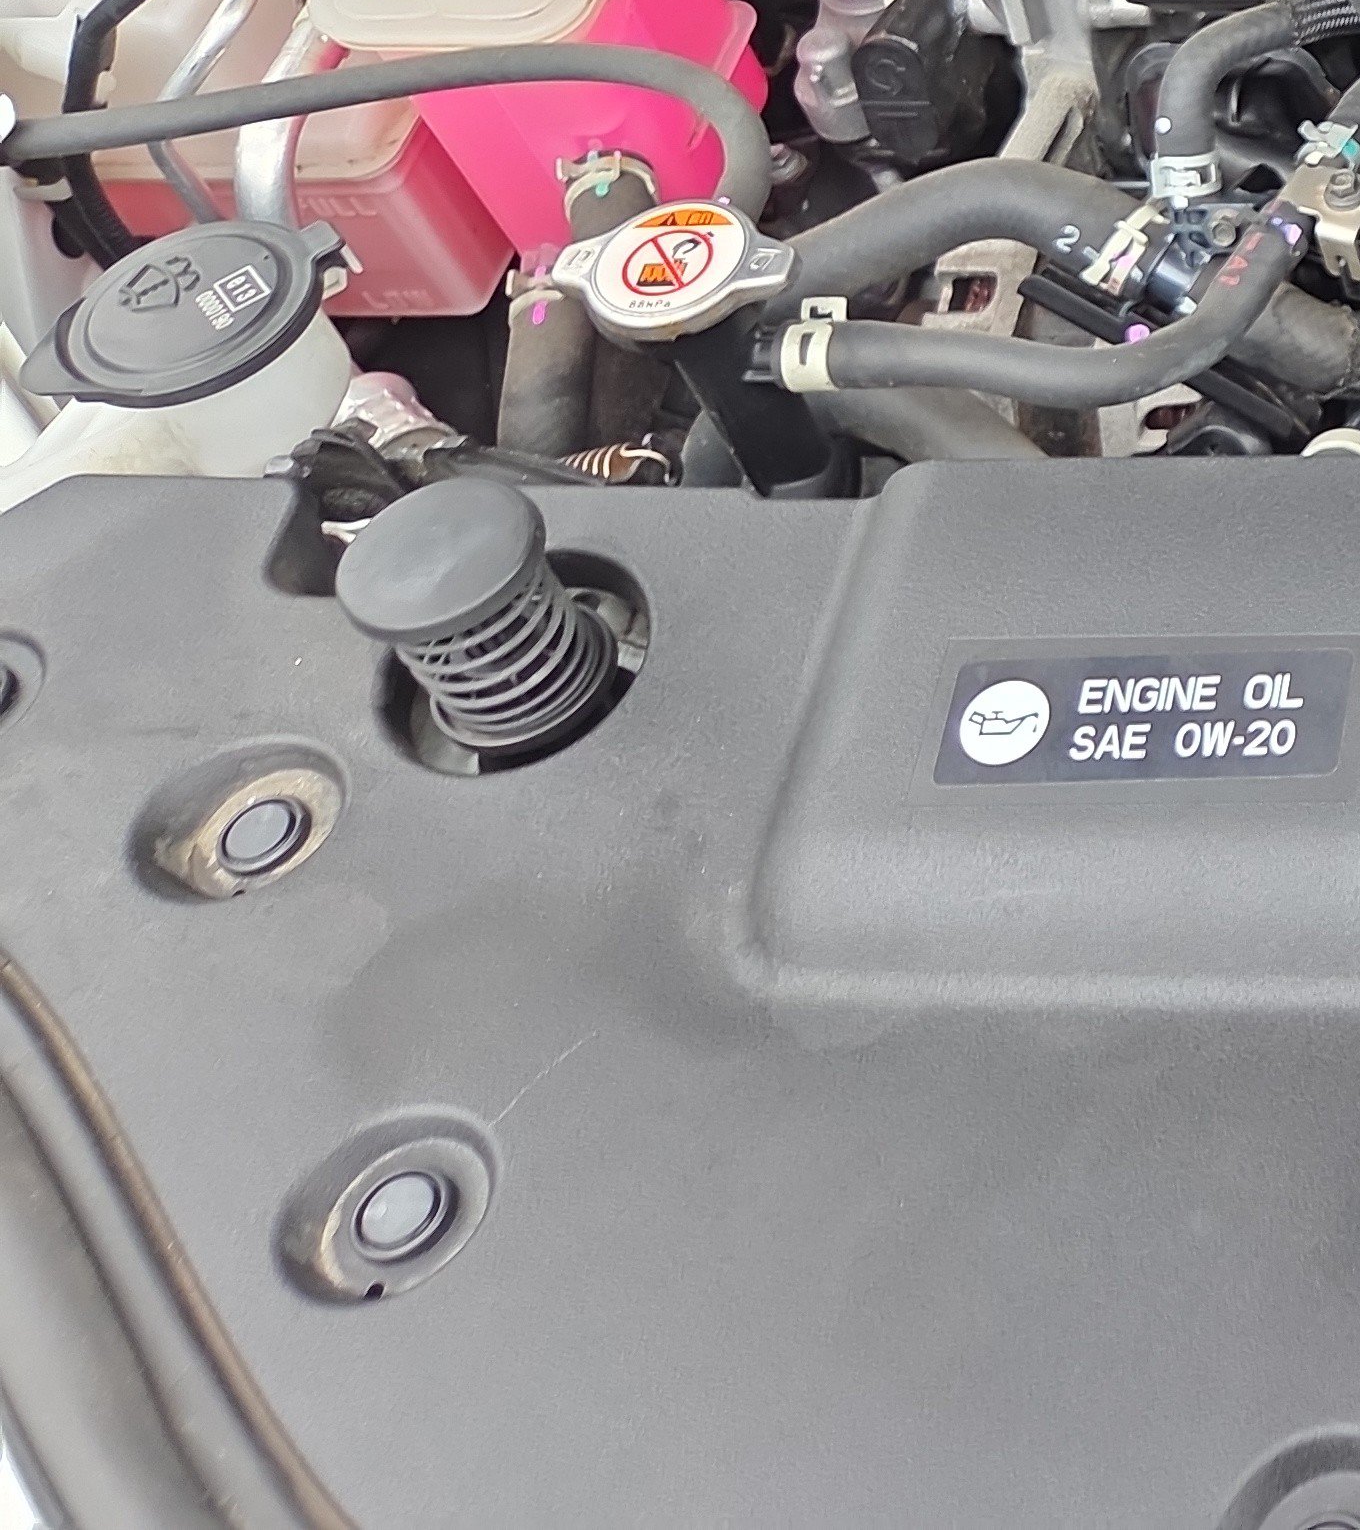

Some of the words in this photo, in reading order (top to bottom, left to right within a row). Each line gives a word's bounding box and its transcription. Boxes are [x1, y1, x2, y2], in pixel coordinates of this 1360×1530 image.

[1077, 674, 1222, 714] ENGINE
[1242, 672, 1304, 711] OIL
[1068, 722, 1151, 761] SAE
[1173, 718, 1297, 758] 0W-20
